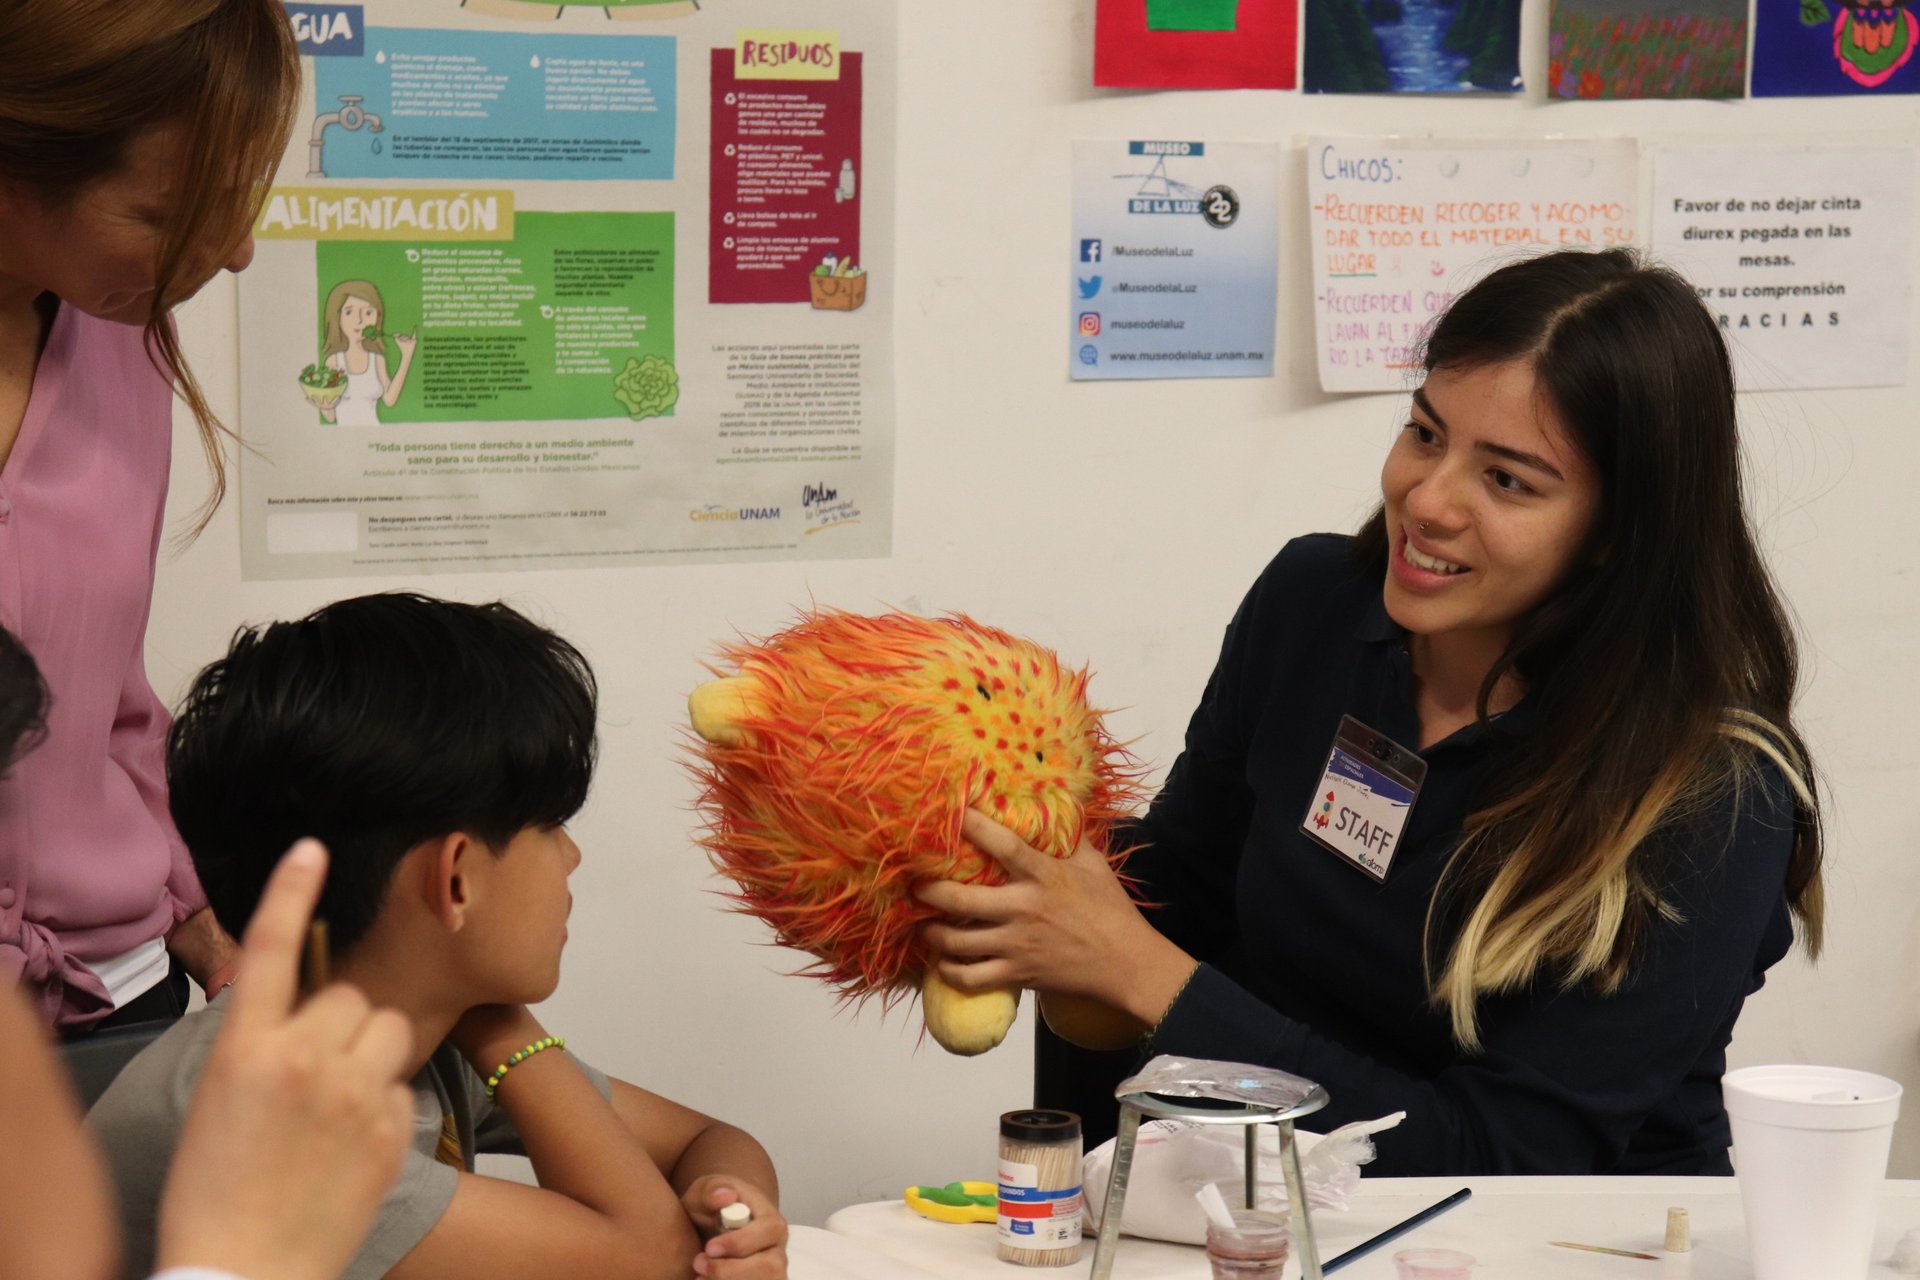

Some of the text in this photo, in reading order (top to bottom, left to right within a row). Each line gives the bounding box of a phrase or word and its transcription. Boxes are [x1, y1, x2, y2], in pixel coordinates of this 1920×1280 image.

[290, 12, 353, 45] GUA
[742, 40, 833, 68] RESIDUOS
[1143, 142, 1190, 155] MUSEO
[1321, 145, 1403, 183] CHICOS:
[260, 193, 498, 232] ALIMENTACIÓN
[1133, 201, 1200, 214] DE LA LUZ
[1435, 202, 1520, 224] RECOGER
[1531, 203, 1541, 224] Y
[1673, 196, 1861, 215] Favor de no dejar cinta
[1327, 226, 1635, 247] DAR TODO EL MATERIAL EN SU
[1683, 224, 1852, 243] diurex pegada en las
[1327, 253, 1376, 273] LUGAR
[1738, 255, 1796, 267] mesas.
[1696, 282, 1846, 300] or su comprensión
[1110, 319, 1185, 330] museodelaluz
[1377, 321, 1394, 343] AL
[1110, 351, 1264, 363] www.museodelaluz.unam.mx
[404, 442, 446, 452] persona
[450, 440, 475, 450] tiene
[479, 439, 522, 450] derecho
[526, 441, 531, 449] a
[551, 438, 583, 448] medio
[587, 437, 634, 448] ambiente
[407, 456, 432, 465] sano
[435, 456, 458, 465] para
[462, 456, 472, 464] su
[477, 452, 529, 463] desarrollo
[533, 454, 538, 463] y
[1335, 806, 1393, 855] STAFF
